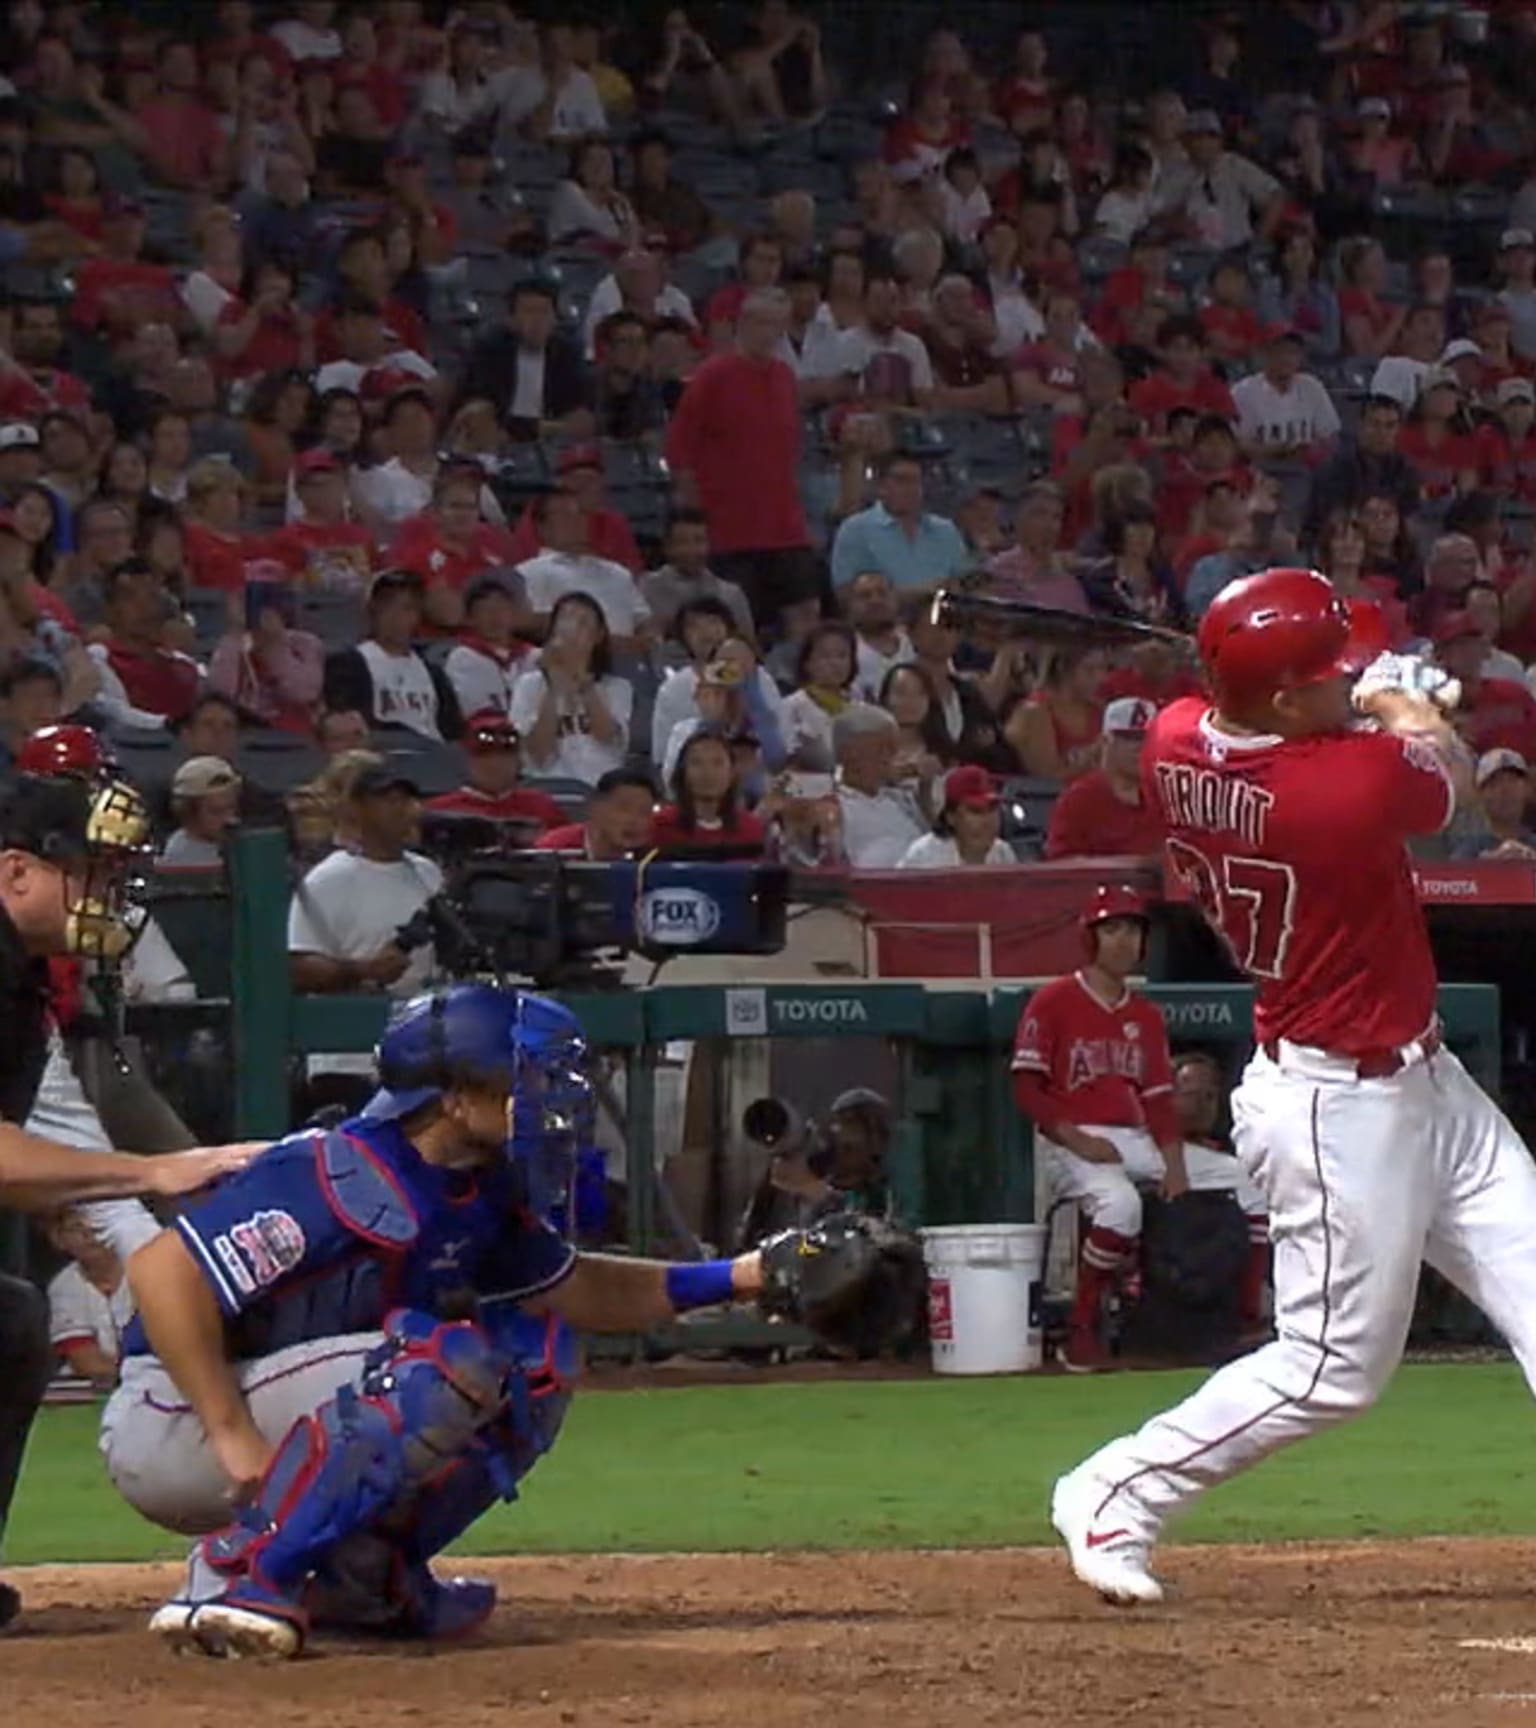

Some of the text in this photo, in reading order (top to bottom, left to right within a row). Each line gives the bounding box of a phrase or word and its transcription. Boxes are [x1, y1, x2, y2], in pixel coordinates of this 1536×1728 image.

[1155, 761, 1275, 850] TROUT
[1421, 880, 1479, 896] TOYOTA
[652, 899, 698, 922] FOX
[773, 999, 868, 1022] TOYOTA
[1162, 1003, 1233, 1024] OYOTA
